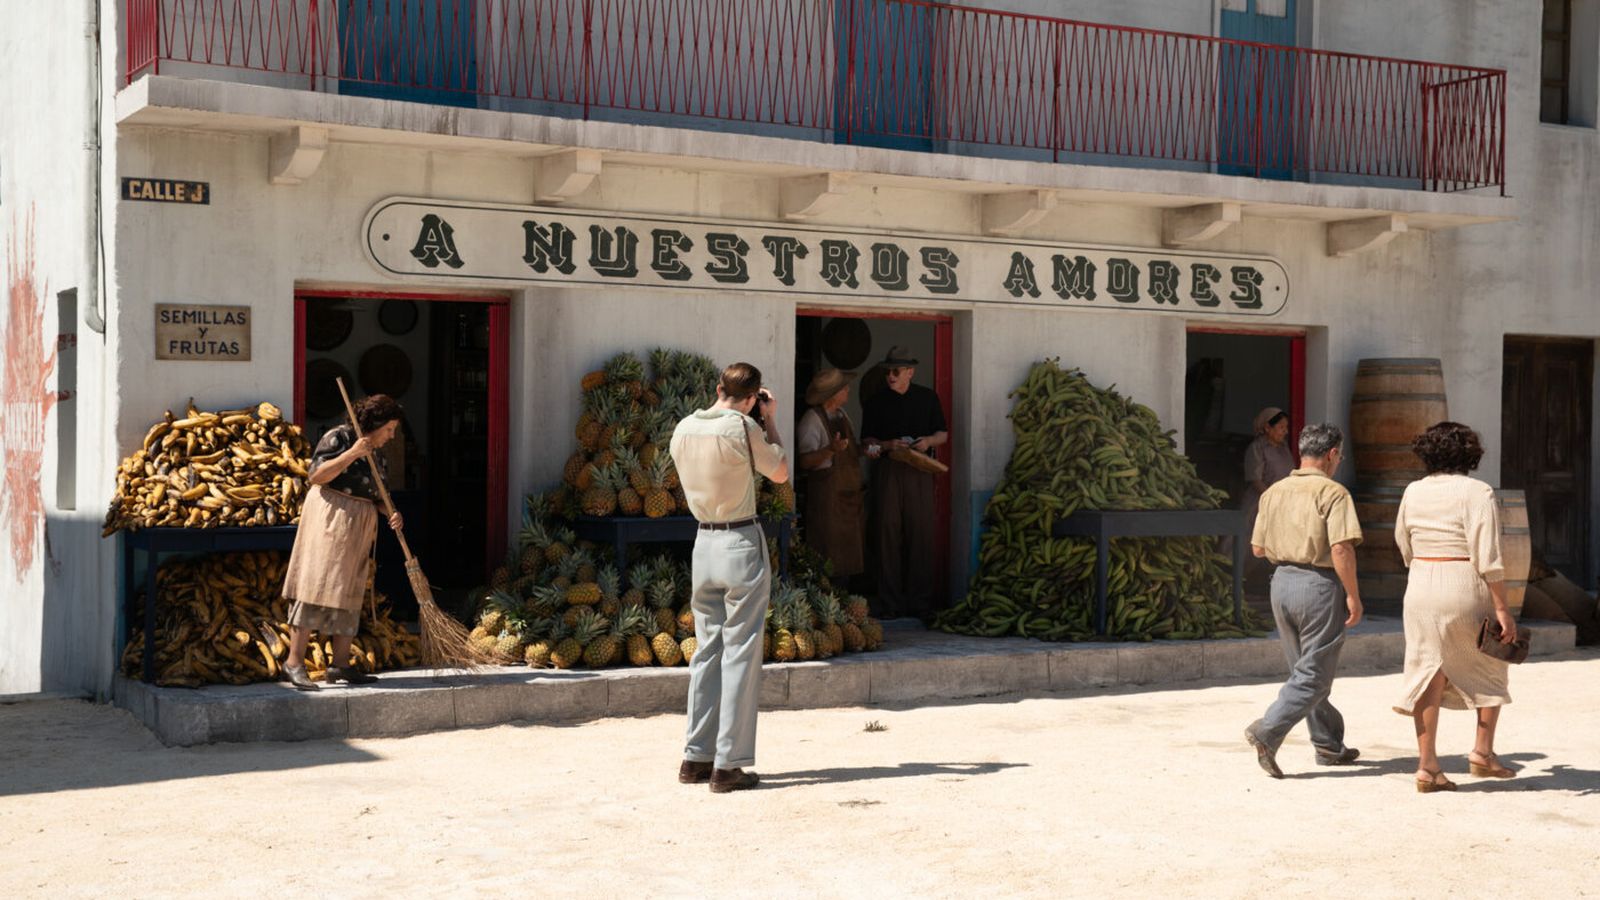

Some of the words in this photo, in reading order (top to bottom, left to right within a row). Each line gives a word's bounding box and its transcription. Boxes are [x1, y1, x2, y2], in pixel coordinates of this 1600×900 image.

[129, 180, 185, 201] CALLE
[191, 184, 203, 203] J
[410, 213, 465, 269] A
[521, 219, 961, 296] NUESTROS
[1003, 250, 1265, 310] AMORES
[160, 310, 247, 326] SEMILLAS
[169, 340, 240, 356] FRUTAS
